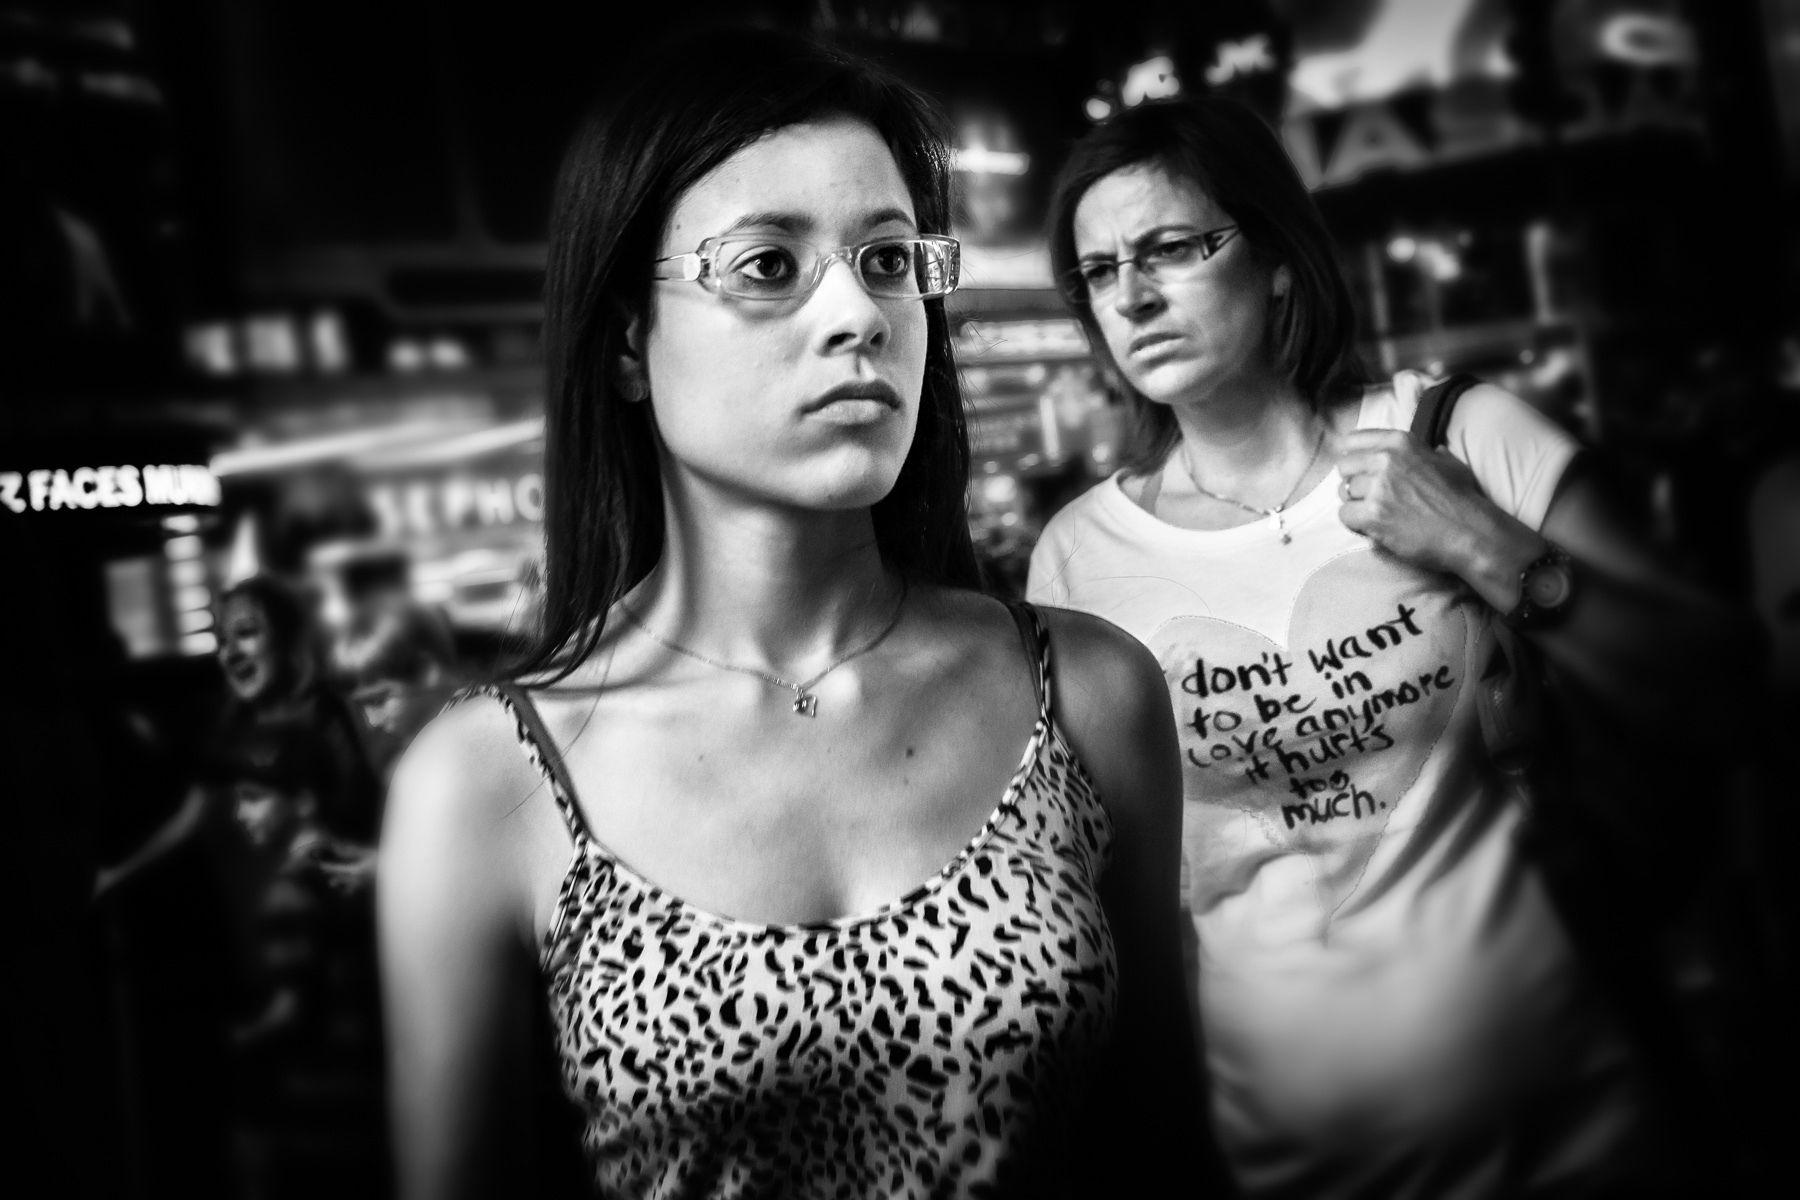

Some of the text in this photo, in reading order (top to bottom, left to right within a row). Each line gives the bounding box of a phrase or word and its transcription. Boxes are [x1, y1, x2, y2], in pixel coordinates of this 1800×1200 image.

[27, 464, 144, 512] FACES
[1181, 651, 1293, 699] don't
[1186, 671, 1373, 740] to be in
[1296, 665, 1455, 735] anymore
[1238, 724, 1395, 785] it hurts
[1281, 783, 1386, 830] much.
[1289, 769, 1350, 800] too
